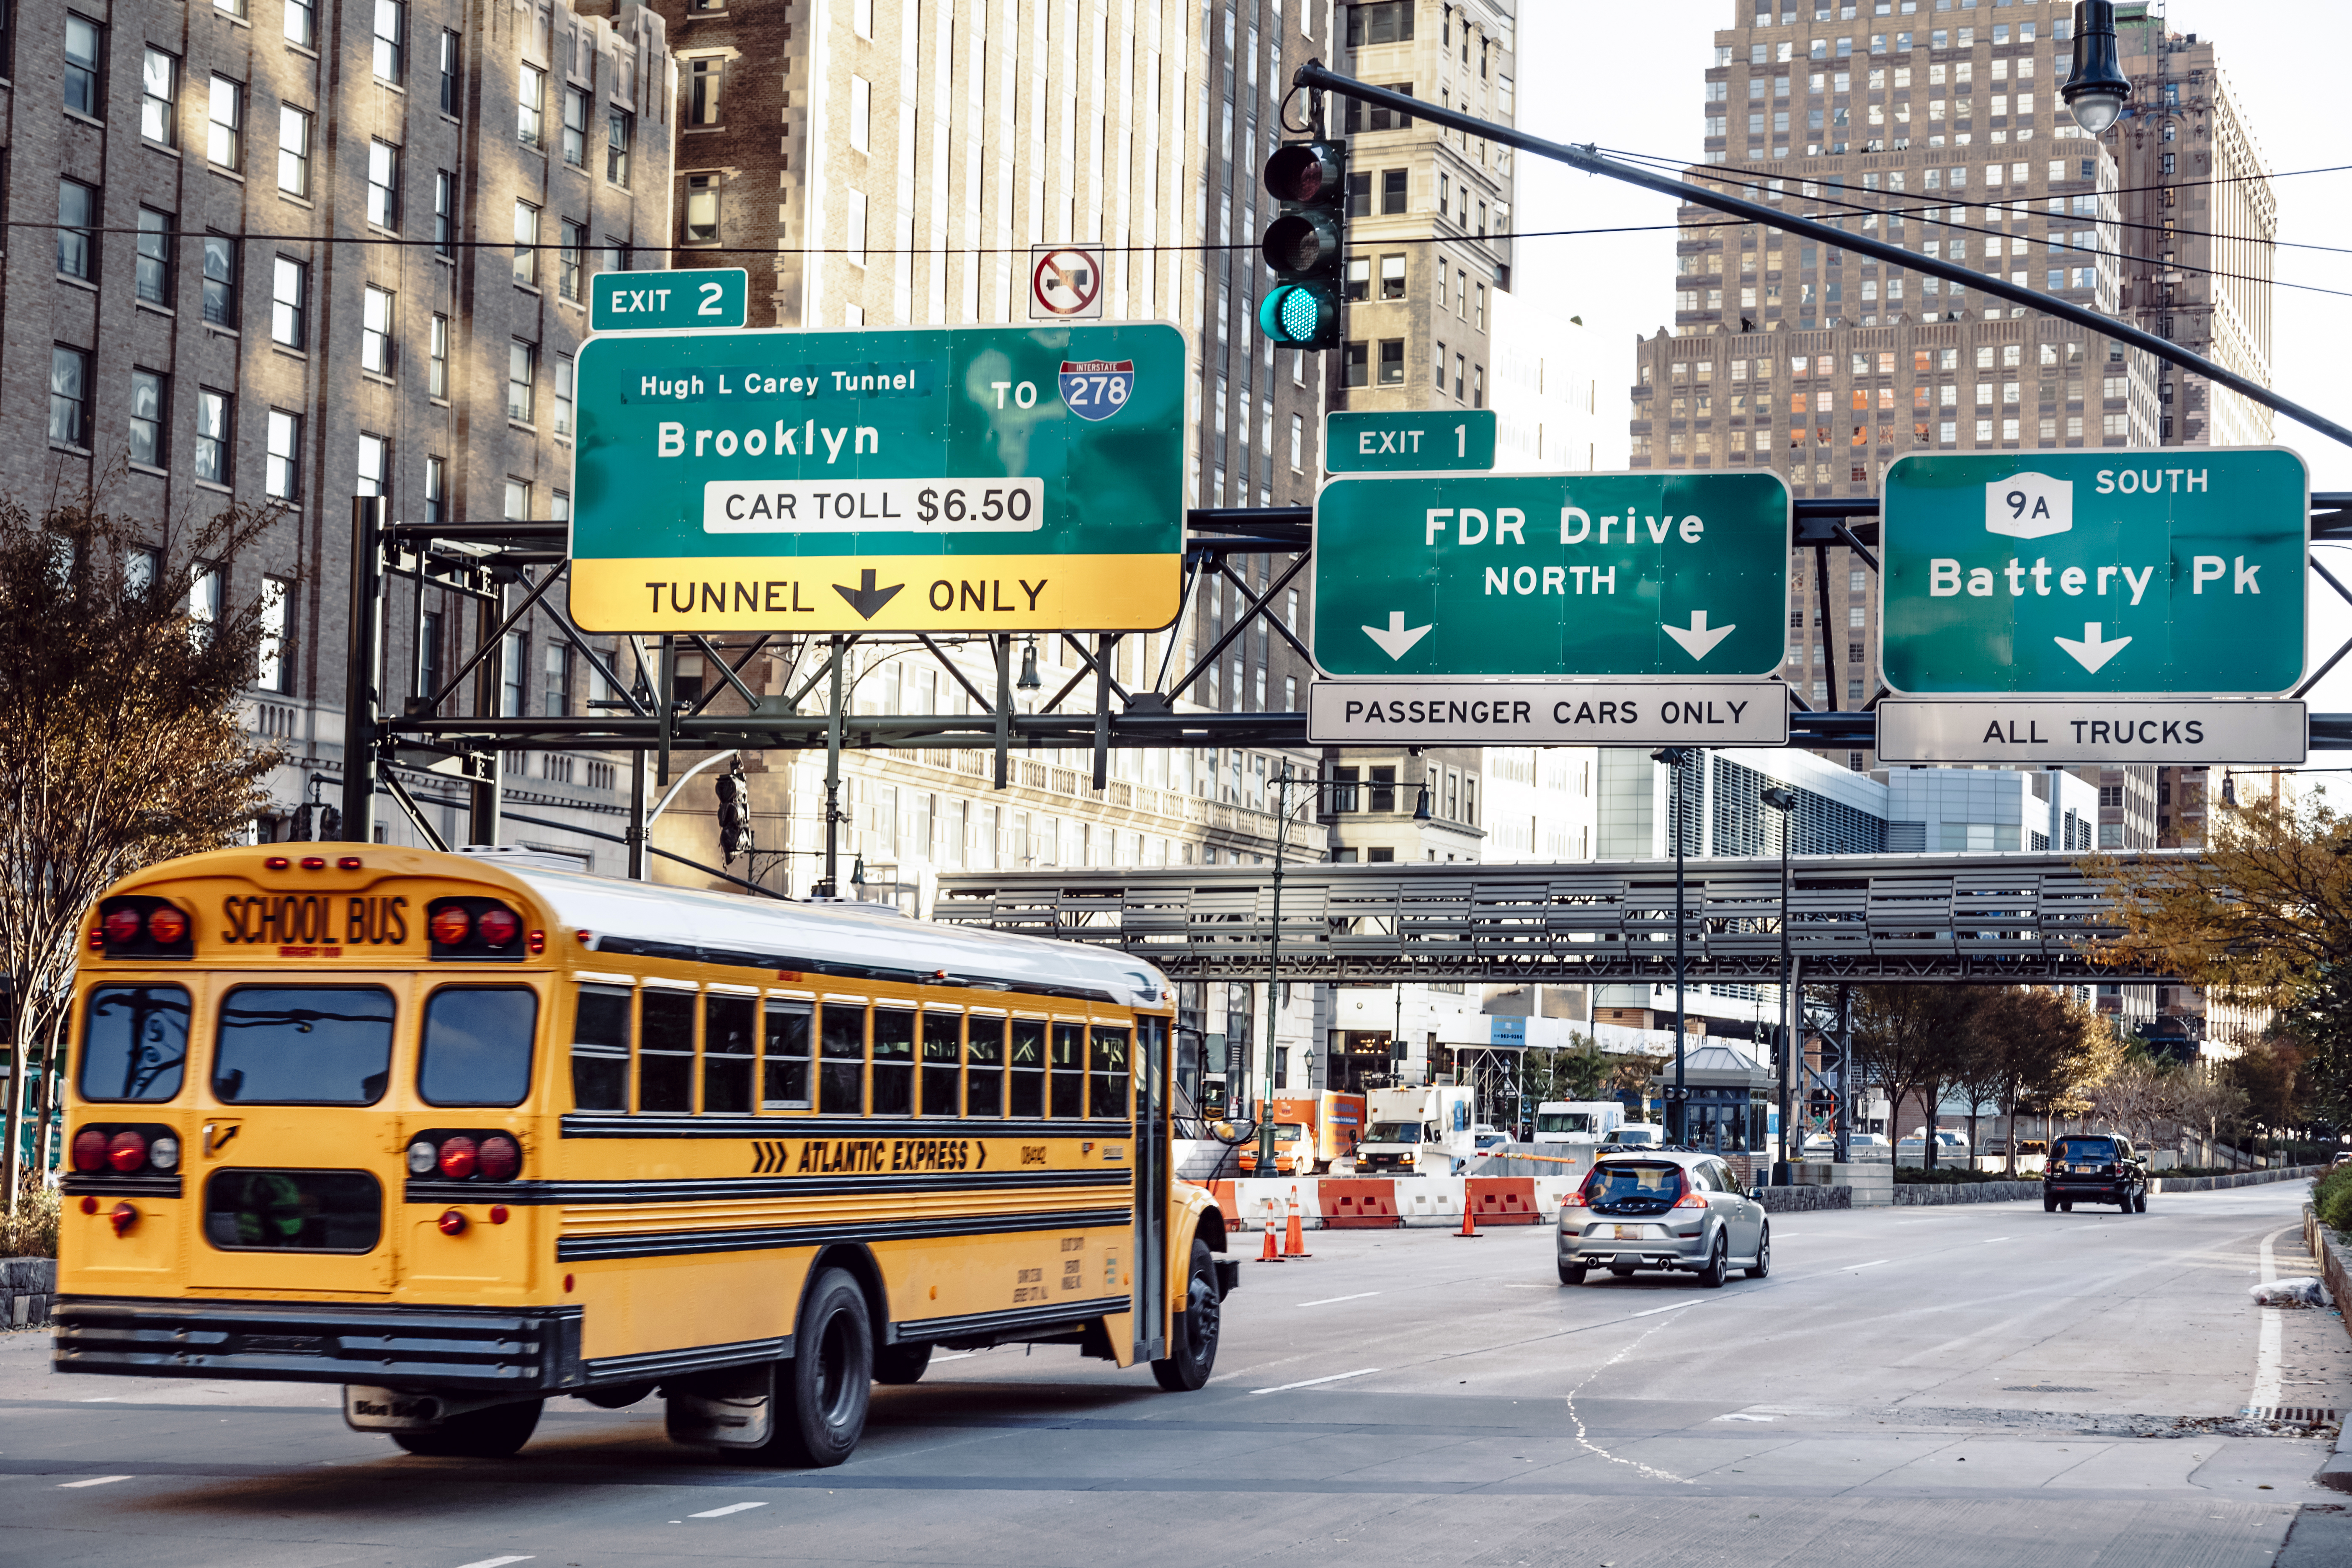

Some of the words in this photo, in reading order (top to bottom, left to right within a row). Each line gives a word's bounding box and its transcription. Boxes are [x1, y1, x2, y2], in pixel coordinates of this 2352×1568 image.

[612, 290, 671, 312] EXIT
[698, 283, 722, 315] 2
[1076, 363, 1117, 372] INTERSTATE
[642, 376, 703, 400] Hugh
[720, 375, 730, 393] L
[745, 374, 818, 395] Carey
[832, 370, 914, 391] Tunnel
[991, 381, 1037, 409] TO
[1069, 377, 1127, 405] 278
[658, 419, 878, 463] Brooklyn
[1360, 431, 1424, 454] EXIT
[1455, 425, 1465, 457] 1
[2096, 469, 2207, 493] SOUTH
[726, 494, 796, 520] CAR
[814, 493, 900, 518] TOLL
[918, 487, 1031, 525] $6.50
[2007, 491, 2049, 518] 9A
[1426, 508, 1525, 545] FDR
[1560, 507, 1703, 544] Drive
[1485, 566, 1615, 595] NORTH
[1931, 557, 2153, 605] Battery
[2194, 556, 2261, 594] Pk
[646, 582, 814, 613] TUNNEL
[930, 580, 1047, 611] ONLY
[1346, 701, 1530, 723] PASSENGER
[1554, 701, 1638, 724] CARS
[1661, 701, 1748, 724] ONLY
[1983, 721, 2048, 743] ALL
[2071, 721, 2203, 744] TRUCKS
[222, 896, 339, 944] SCHOOL
[346, 896, 409, 944] BUS
[797, 1140, 887, 1172] ATLANTIC
[891, 1140, 969, 1171] EXPRESS
